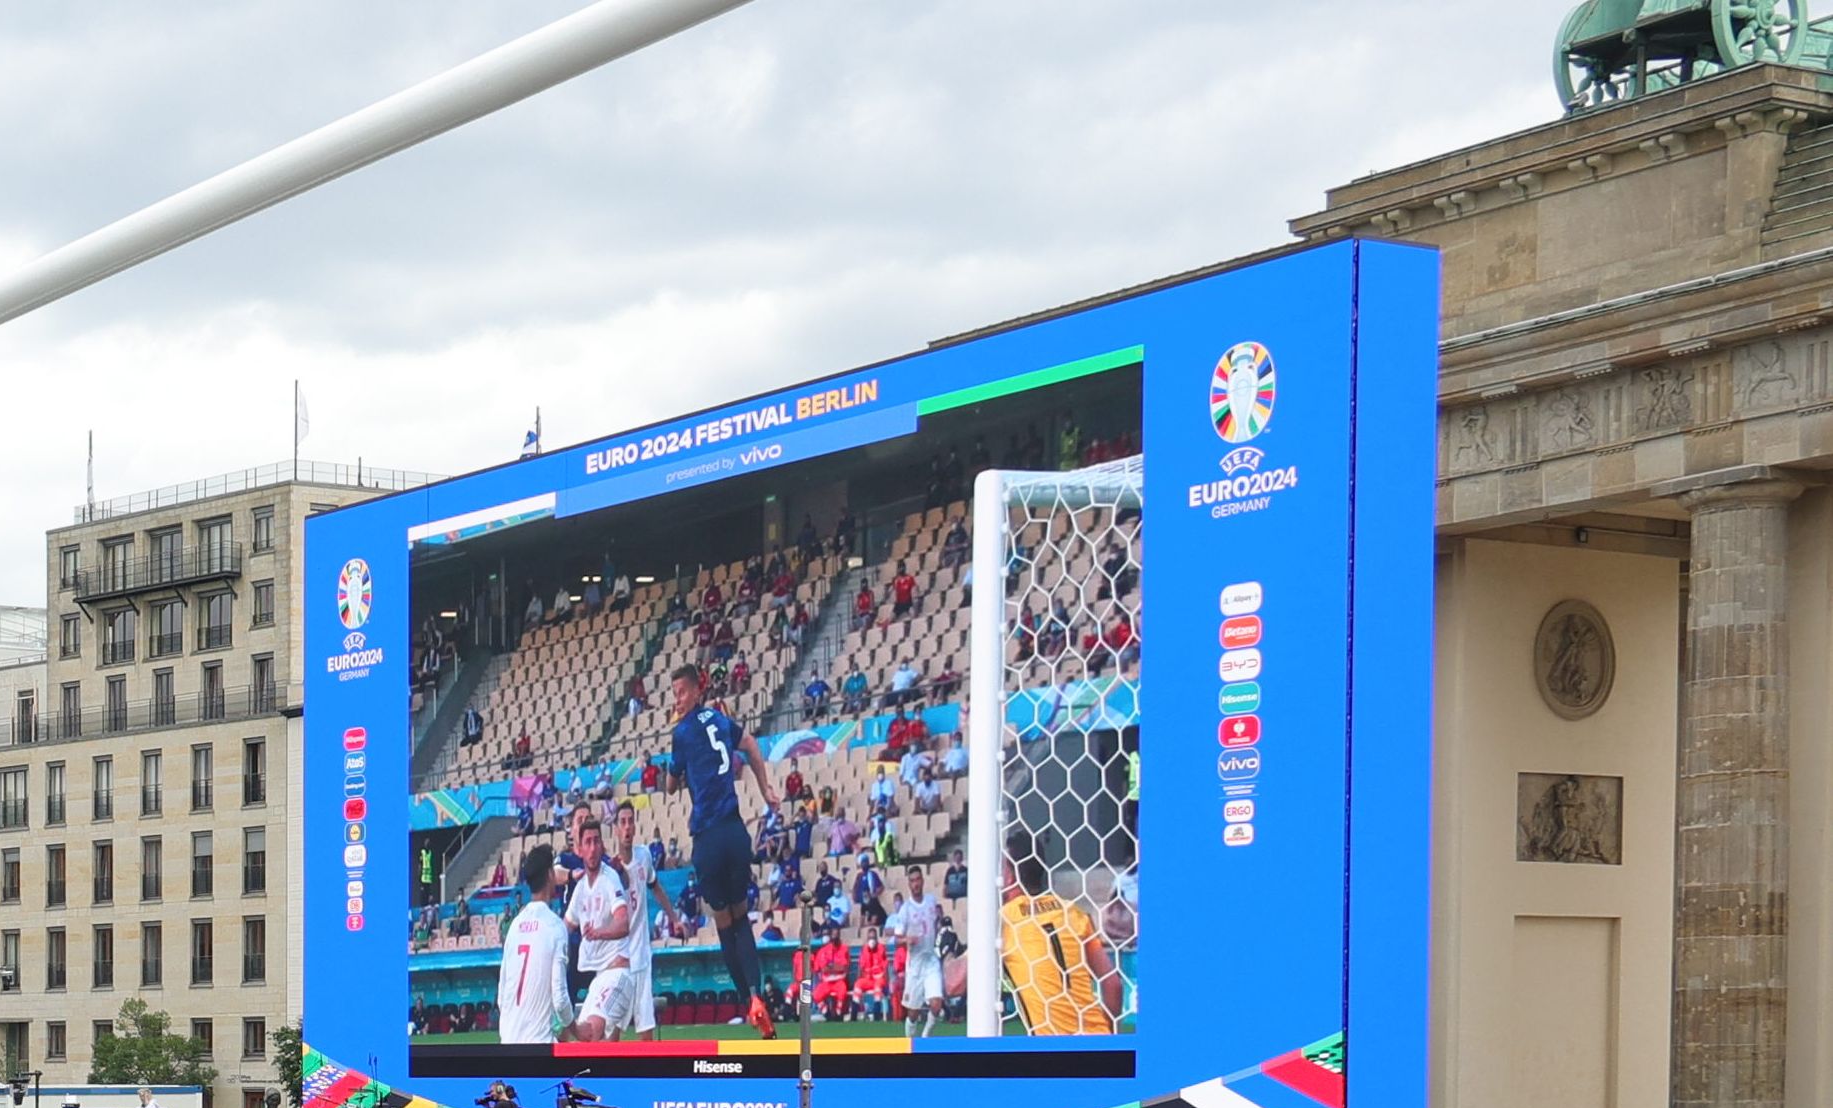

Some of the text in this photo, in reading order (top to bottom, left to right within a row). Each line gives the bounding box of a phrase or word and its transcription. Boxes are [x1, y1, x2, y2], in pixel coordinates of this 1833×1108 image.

[586, 380, 878, 475] EURO 2024 FESTIVAL BERLIN
[666, 444, 782, 484] presented by vivo
[1221, 450, 1260, 473] UEFA
[1188, 466, 1298, 507] EURO2024
[1211, 496, 1271, 519] GERMANY
[344, 634, 365, 648] UEFA
[327, 648, 384, 673] EURO2024
[1221, 658, 1258, 672] BYD
[338, 668, 370, 682] GERMANY
[1221, 693, 1258, 704] Hisense
[706, 724, 730, 775] 5
[1219, 757, 1258, 772] vivo
[1226, 805, 1251, 817] ERGO
[517, 944, 531, 1007] 7
[694, 1060, 743, 1073] Hisense
